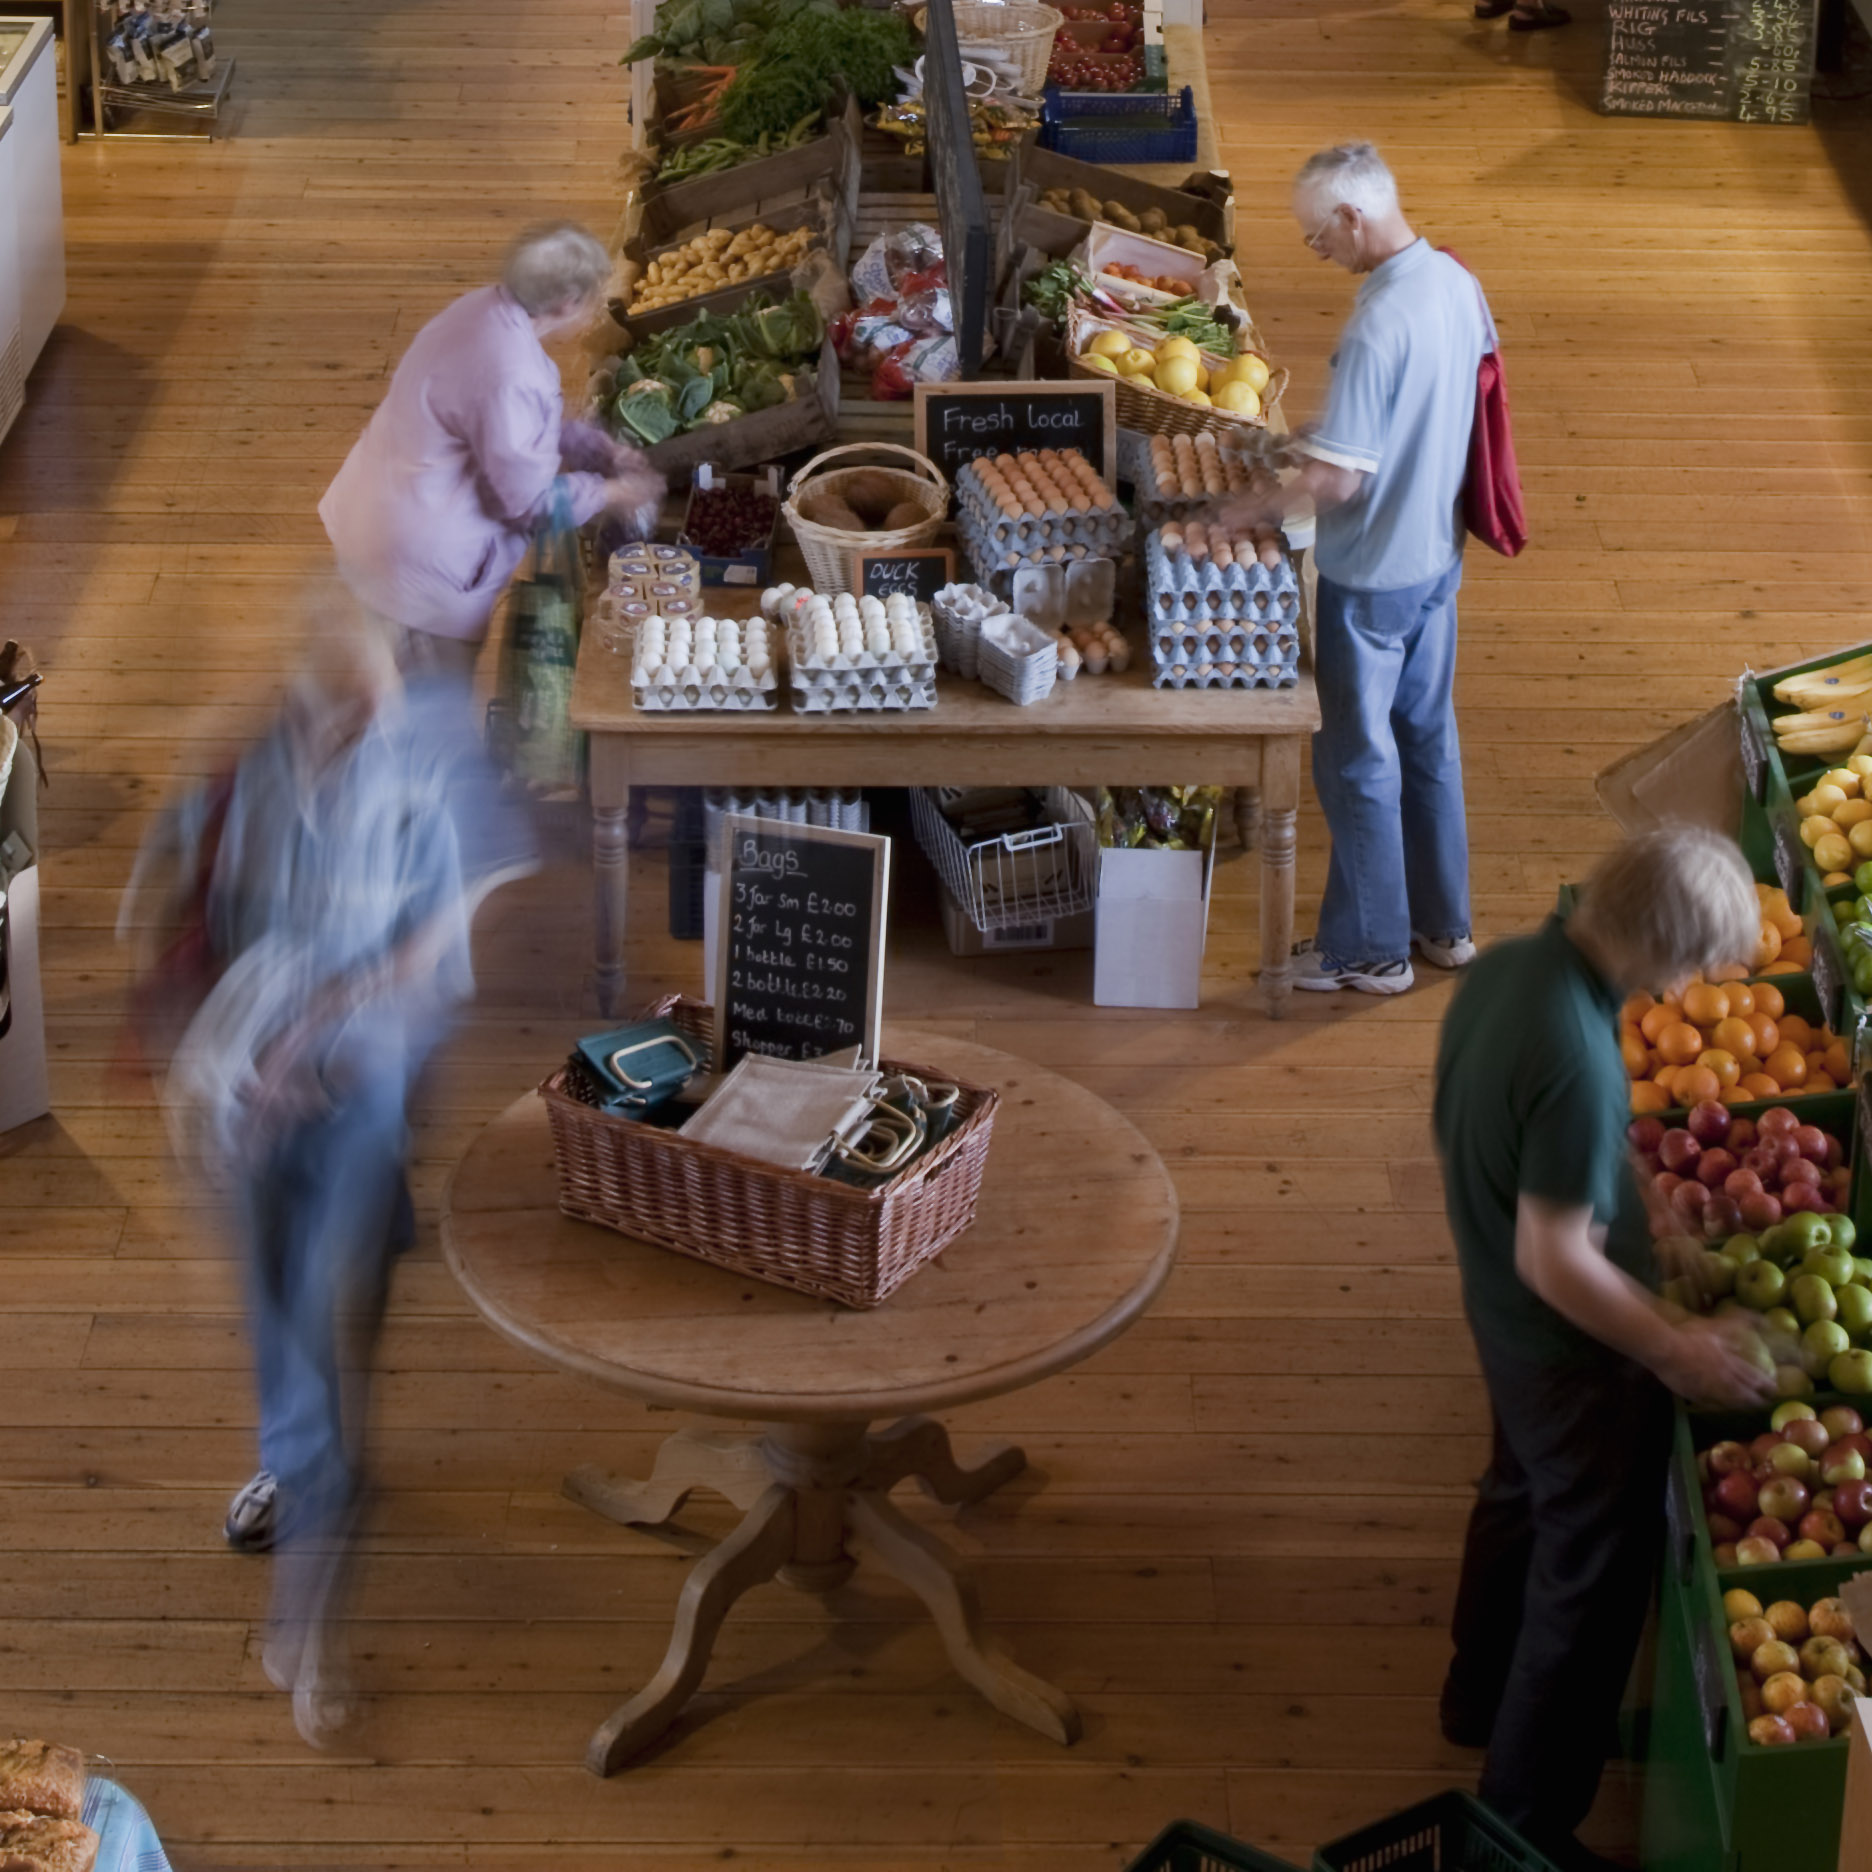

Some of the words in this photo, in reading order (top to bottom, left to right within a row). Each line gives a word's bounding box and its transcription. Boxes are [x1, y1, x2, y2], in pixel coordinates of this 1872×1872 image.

[944, 402, 1014, 432] Fresh
[1028, 404, 1085, 428] local
[870, 561, 921, 581] DUCK
[743, 839, 799, 880] Bags
[747, 946, 797, 968] bottle
